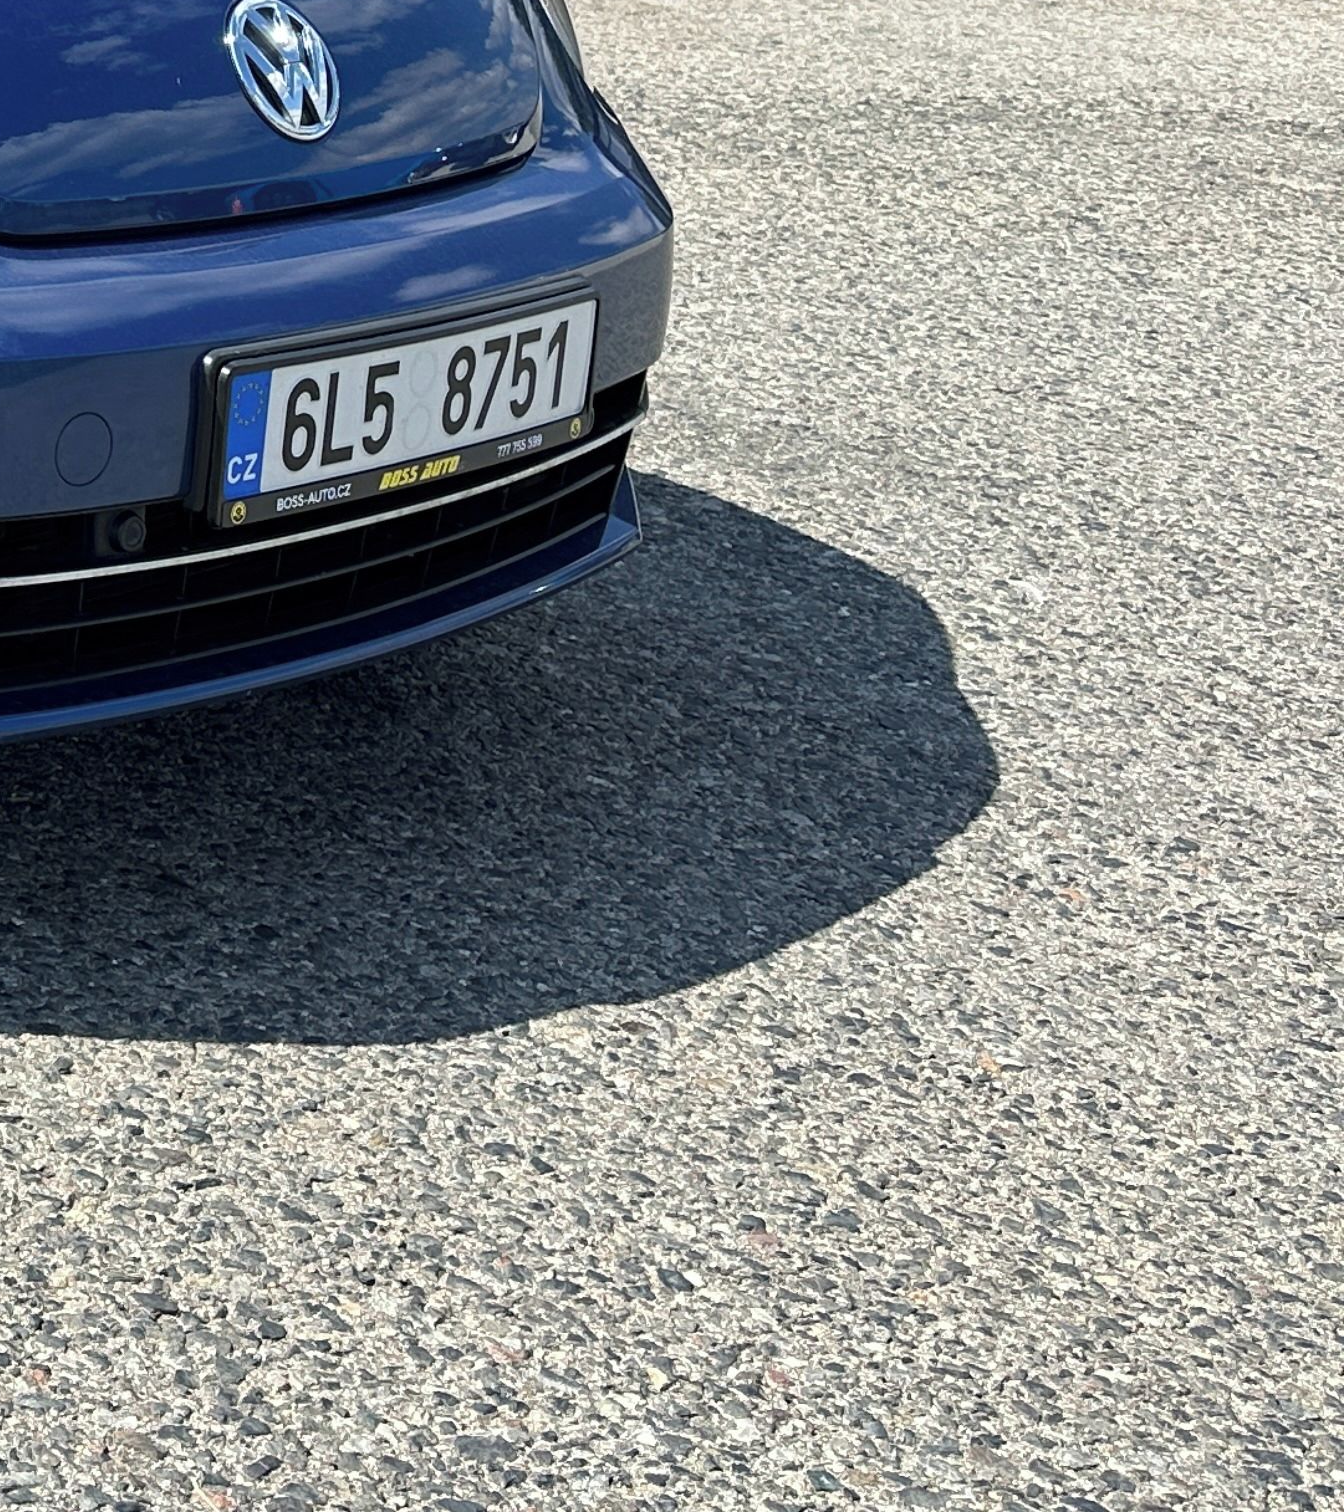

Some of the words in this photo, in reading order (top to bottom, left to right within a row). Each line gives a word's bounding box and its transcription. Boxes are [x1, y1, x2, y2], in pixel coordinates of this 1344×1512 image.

[281, 360, 401, 473] 6L5
[441, 319, 570, 437] 8751
[226, 452, 258, 484] CZ
[378, 465, 418, 491] BOSS
[420, 455, 461, 481] AUTO
[276, 482, 352, 512] BOSS-AUTO.CZ
